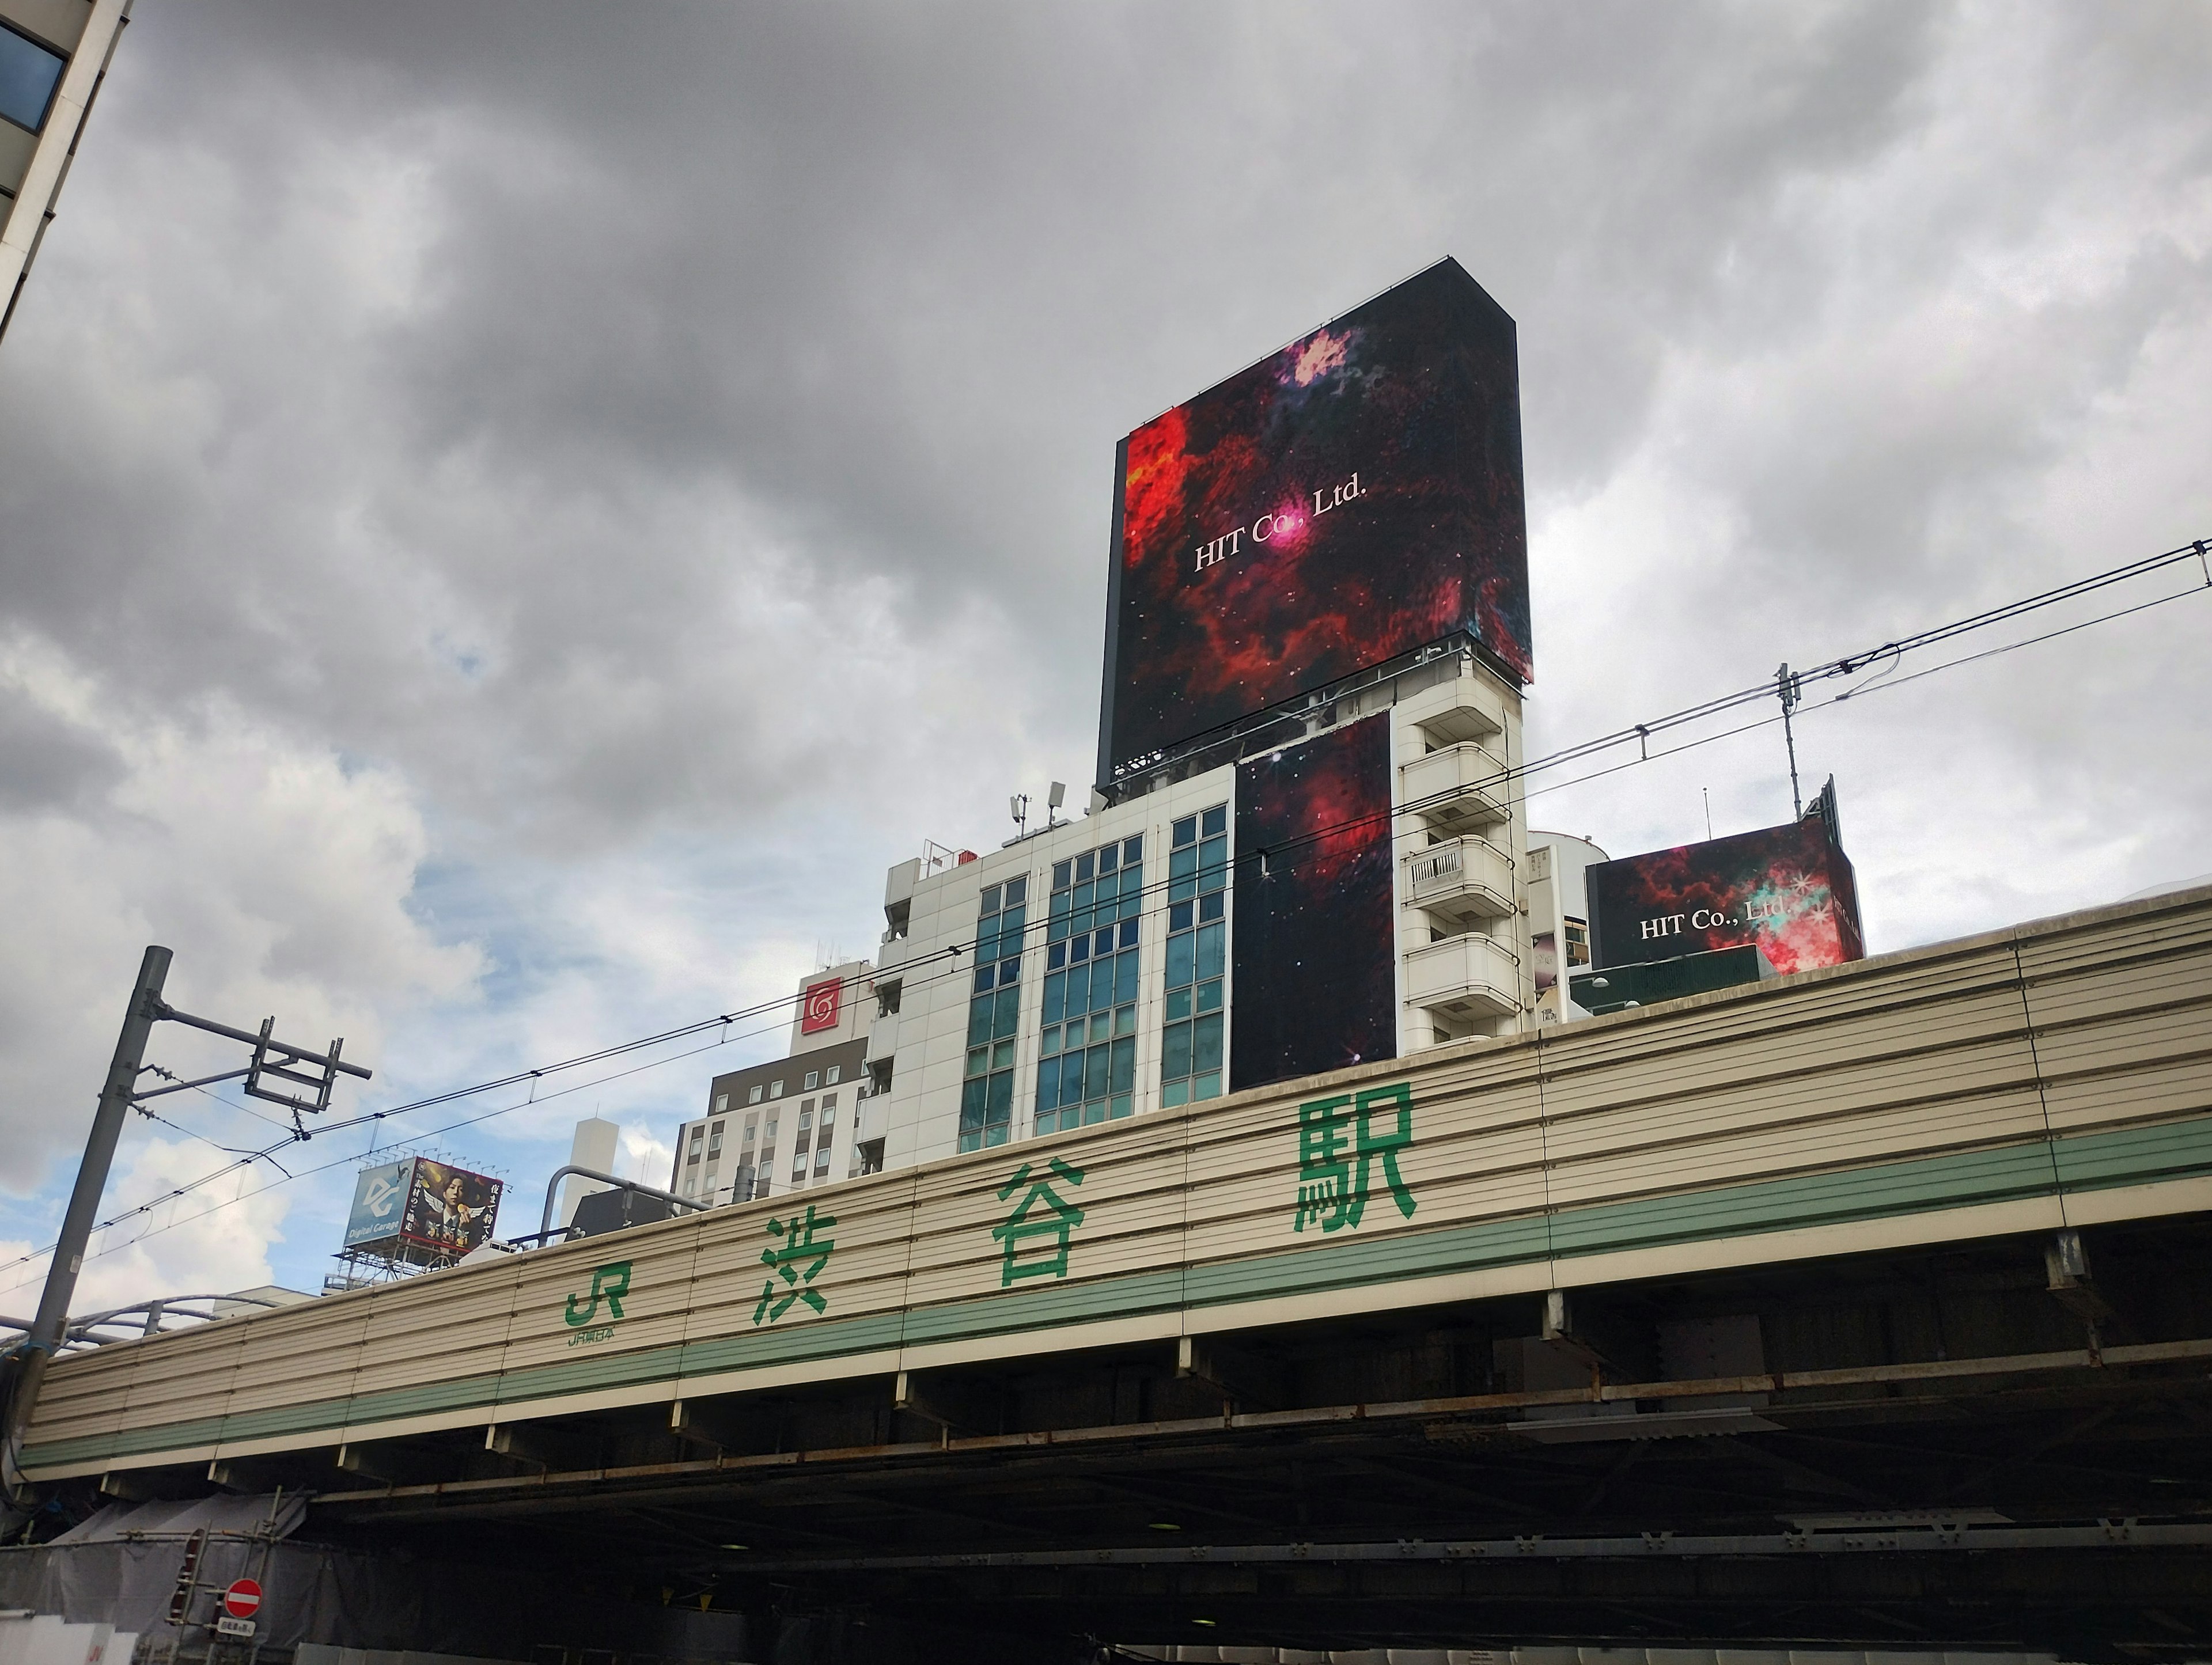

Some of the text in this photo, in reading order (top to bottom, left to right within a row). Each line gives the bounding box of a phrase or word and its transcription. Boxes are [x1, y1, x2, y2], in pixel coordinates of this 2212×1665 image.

[1194, 472, 1367, 573] HIT Co., Ltd.
[1639, 896, 1791, 940] HIT Co., Ltd.
[349, 1220, 400, 1239] Digital Garage
[752, 1081, 1417, 1327] 渋谷駅
[565, 1260, 634, 1327] JR
